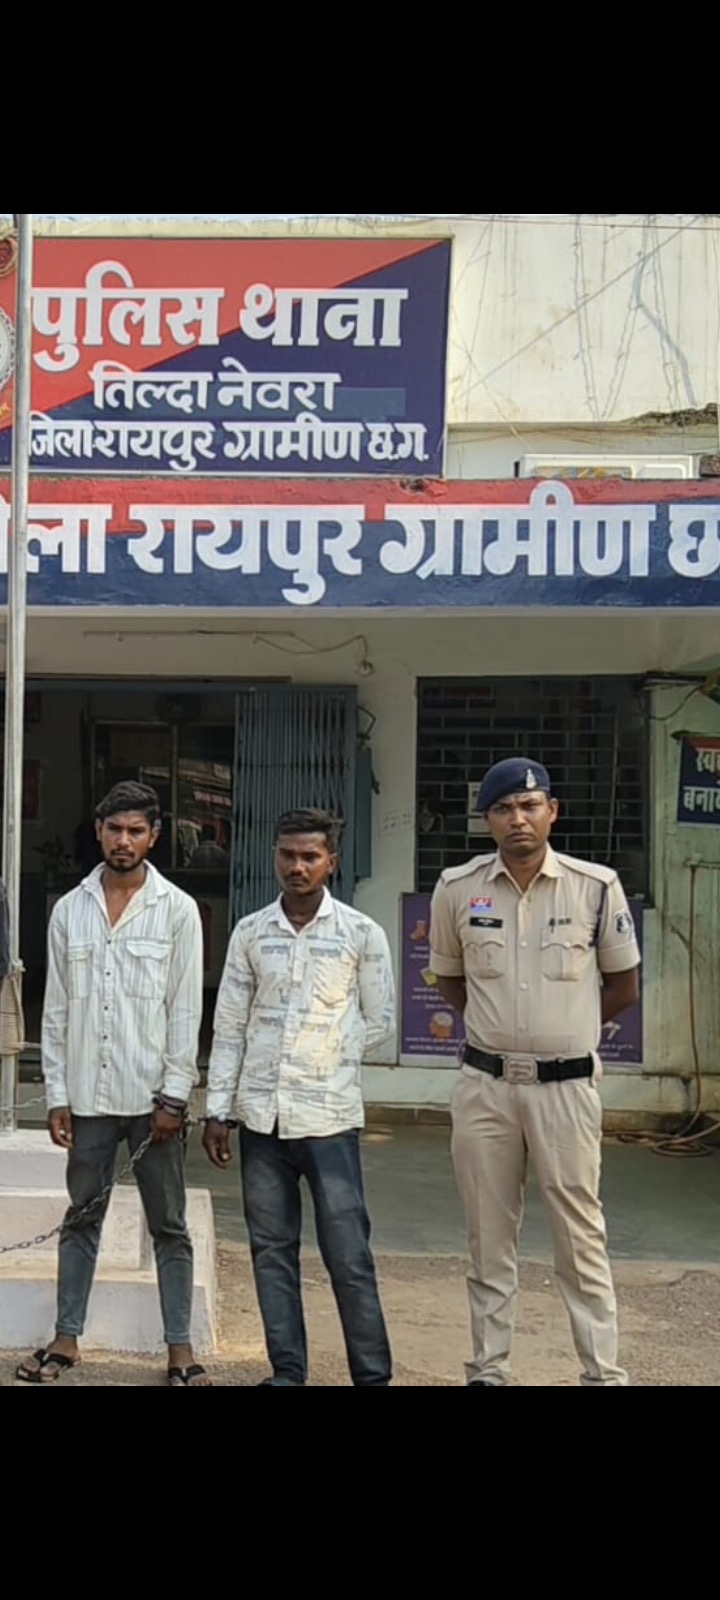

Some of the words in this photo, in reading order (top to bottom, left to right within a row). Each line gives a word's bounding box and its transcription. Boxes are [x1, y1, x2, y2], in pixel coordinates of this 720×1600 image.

[31, 261, 224, 371] पुलिस
[239, 284, 408, 347] थाना
[90, 361, 213, 413] तिल्दा
[218, 357, 341, 412] नेवरा
[222, 412, 363, 463] ग्रामीण
[365, 422, 430, 462] छ.ग.
[127, 504, 364, 606] रायपुर
[379, 480, 657, 580] ग्रामीण
